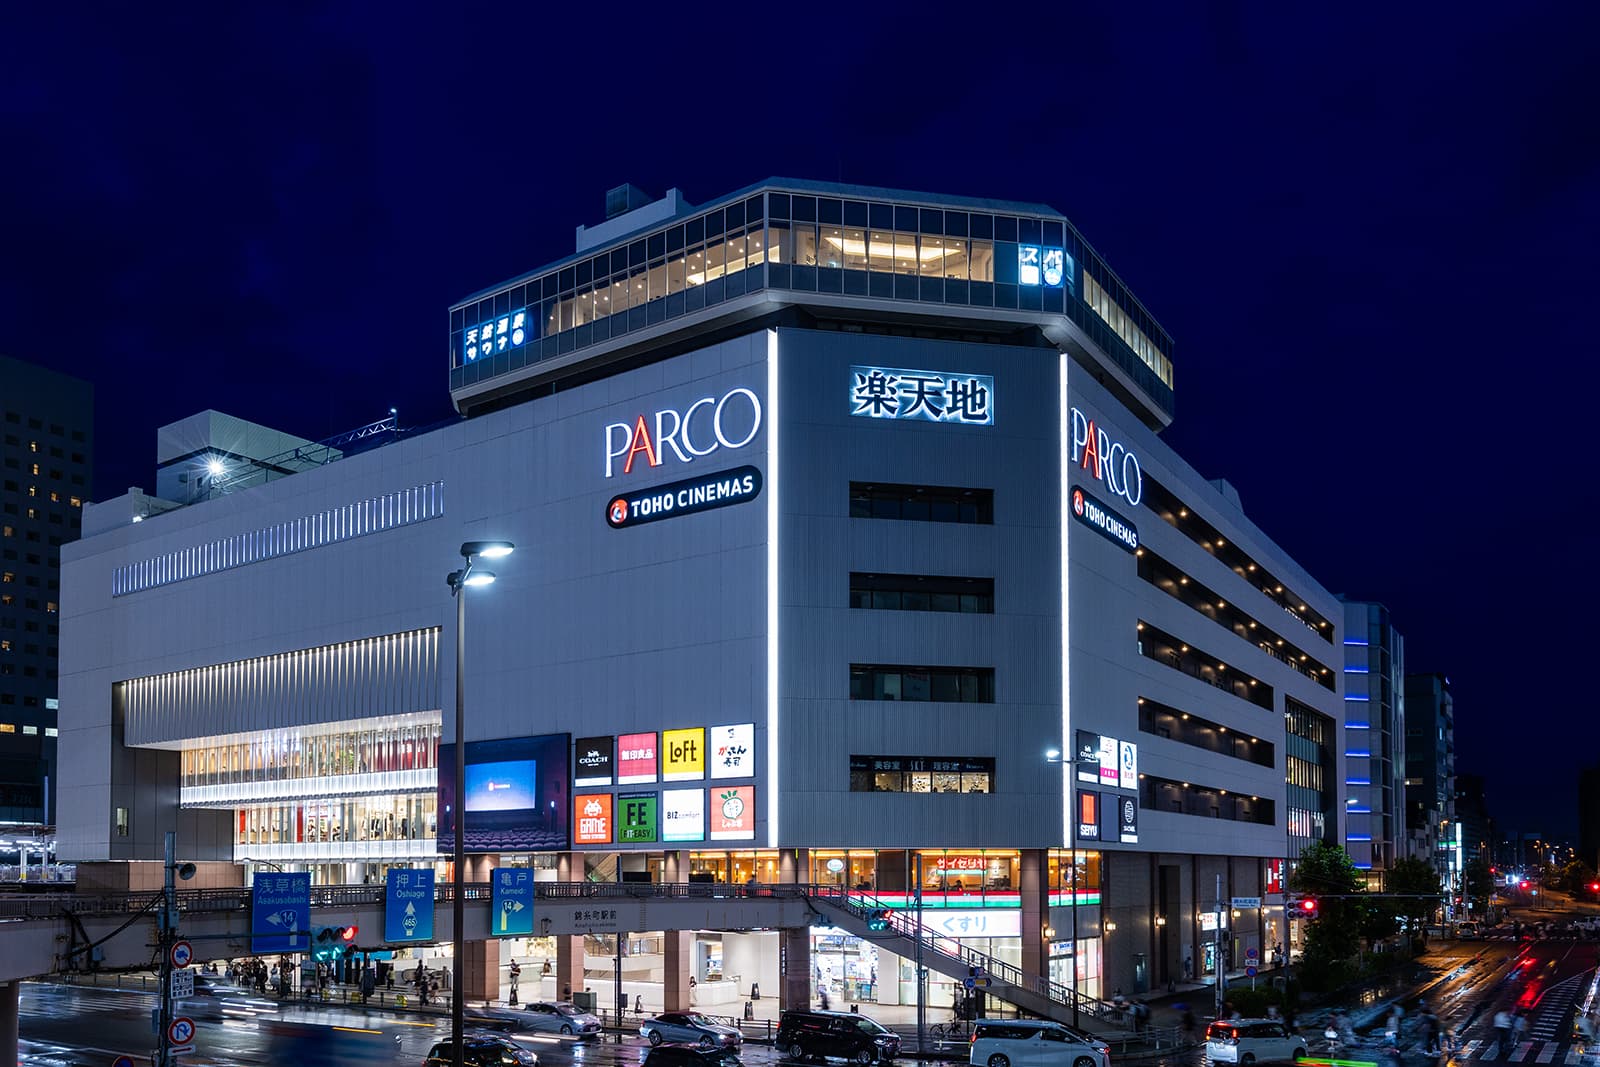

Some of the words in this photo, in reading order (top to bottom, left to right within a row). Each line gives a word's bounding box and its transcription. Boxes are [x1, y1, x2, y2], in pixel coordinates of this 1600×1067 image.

[855, 371, 989, 422] 楽天地
[605, 388, 762, 478] PARCO
[1071, 407, 1142, 506] PARCO
[631, 493, 674, 517] TOHO
[678, 475, 754, 508] CINEMAS
[1084, 502, 1105, 528] TOHO
[1106, 516, 1137, 548] CINEMAS
[579, 755, 609, 765] COACH
[580, 817, 607, 834] GAME
[1080, 824, 1098, 837] SEIYU
[937, 857, 988, 870] サイゼリヤ
[258, 878, 306, 894] 浅草橋
[396, 873, 427, 888] 押上
[501, 872, 527, 886] 亀戸
[396, 889, 425, 899] Oshiage
[500, 887, 527, 896] Kameido
[503, 901, 512, 910] 14
[283, 912, 294, 923] 14
[404, 918, 416, 927] 465
[943, 916, 987, 932] くすり
